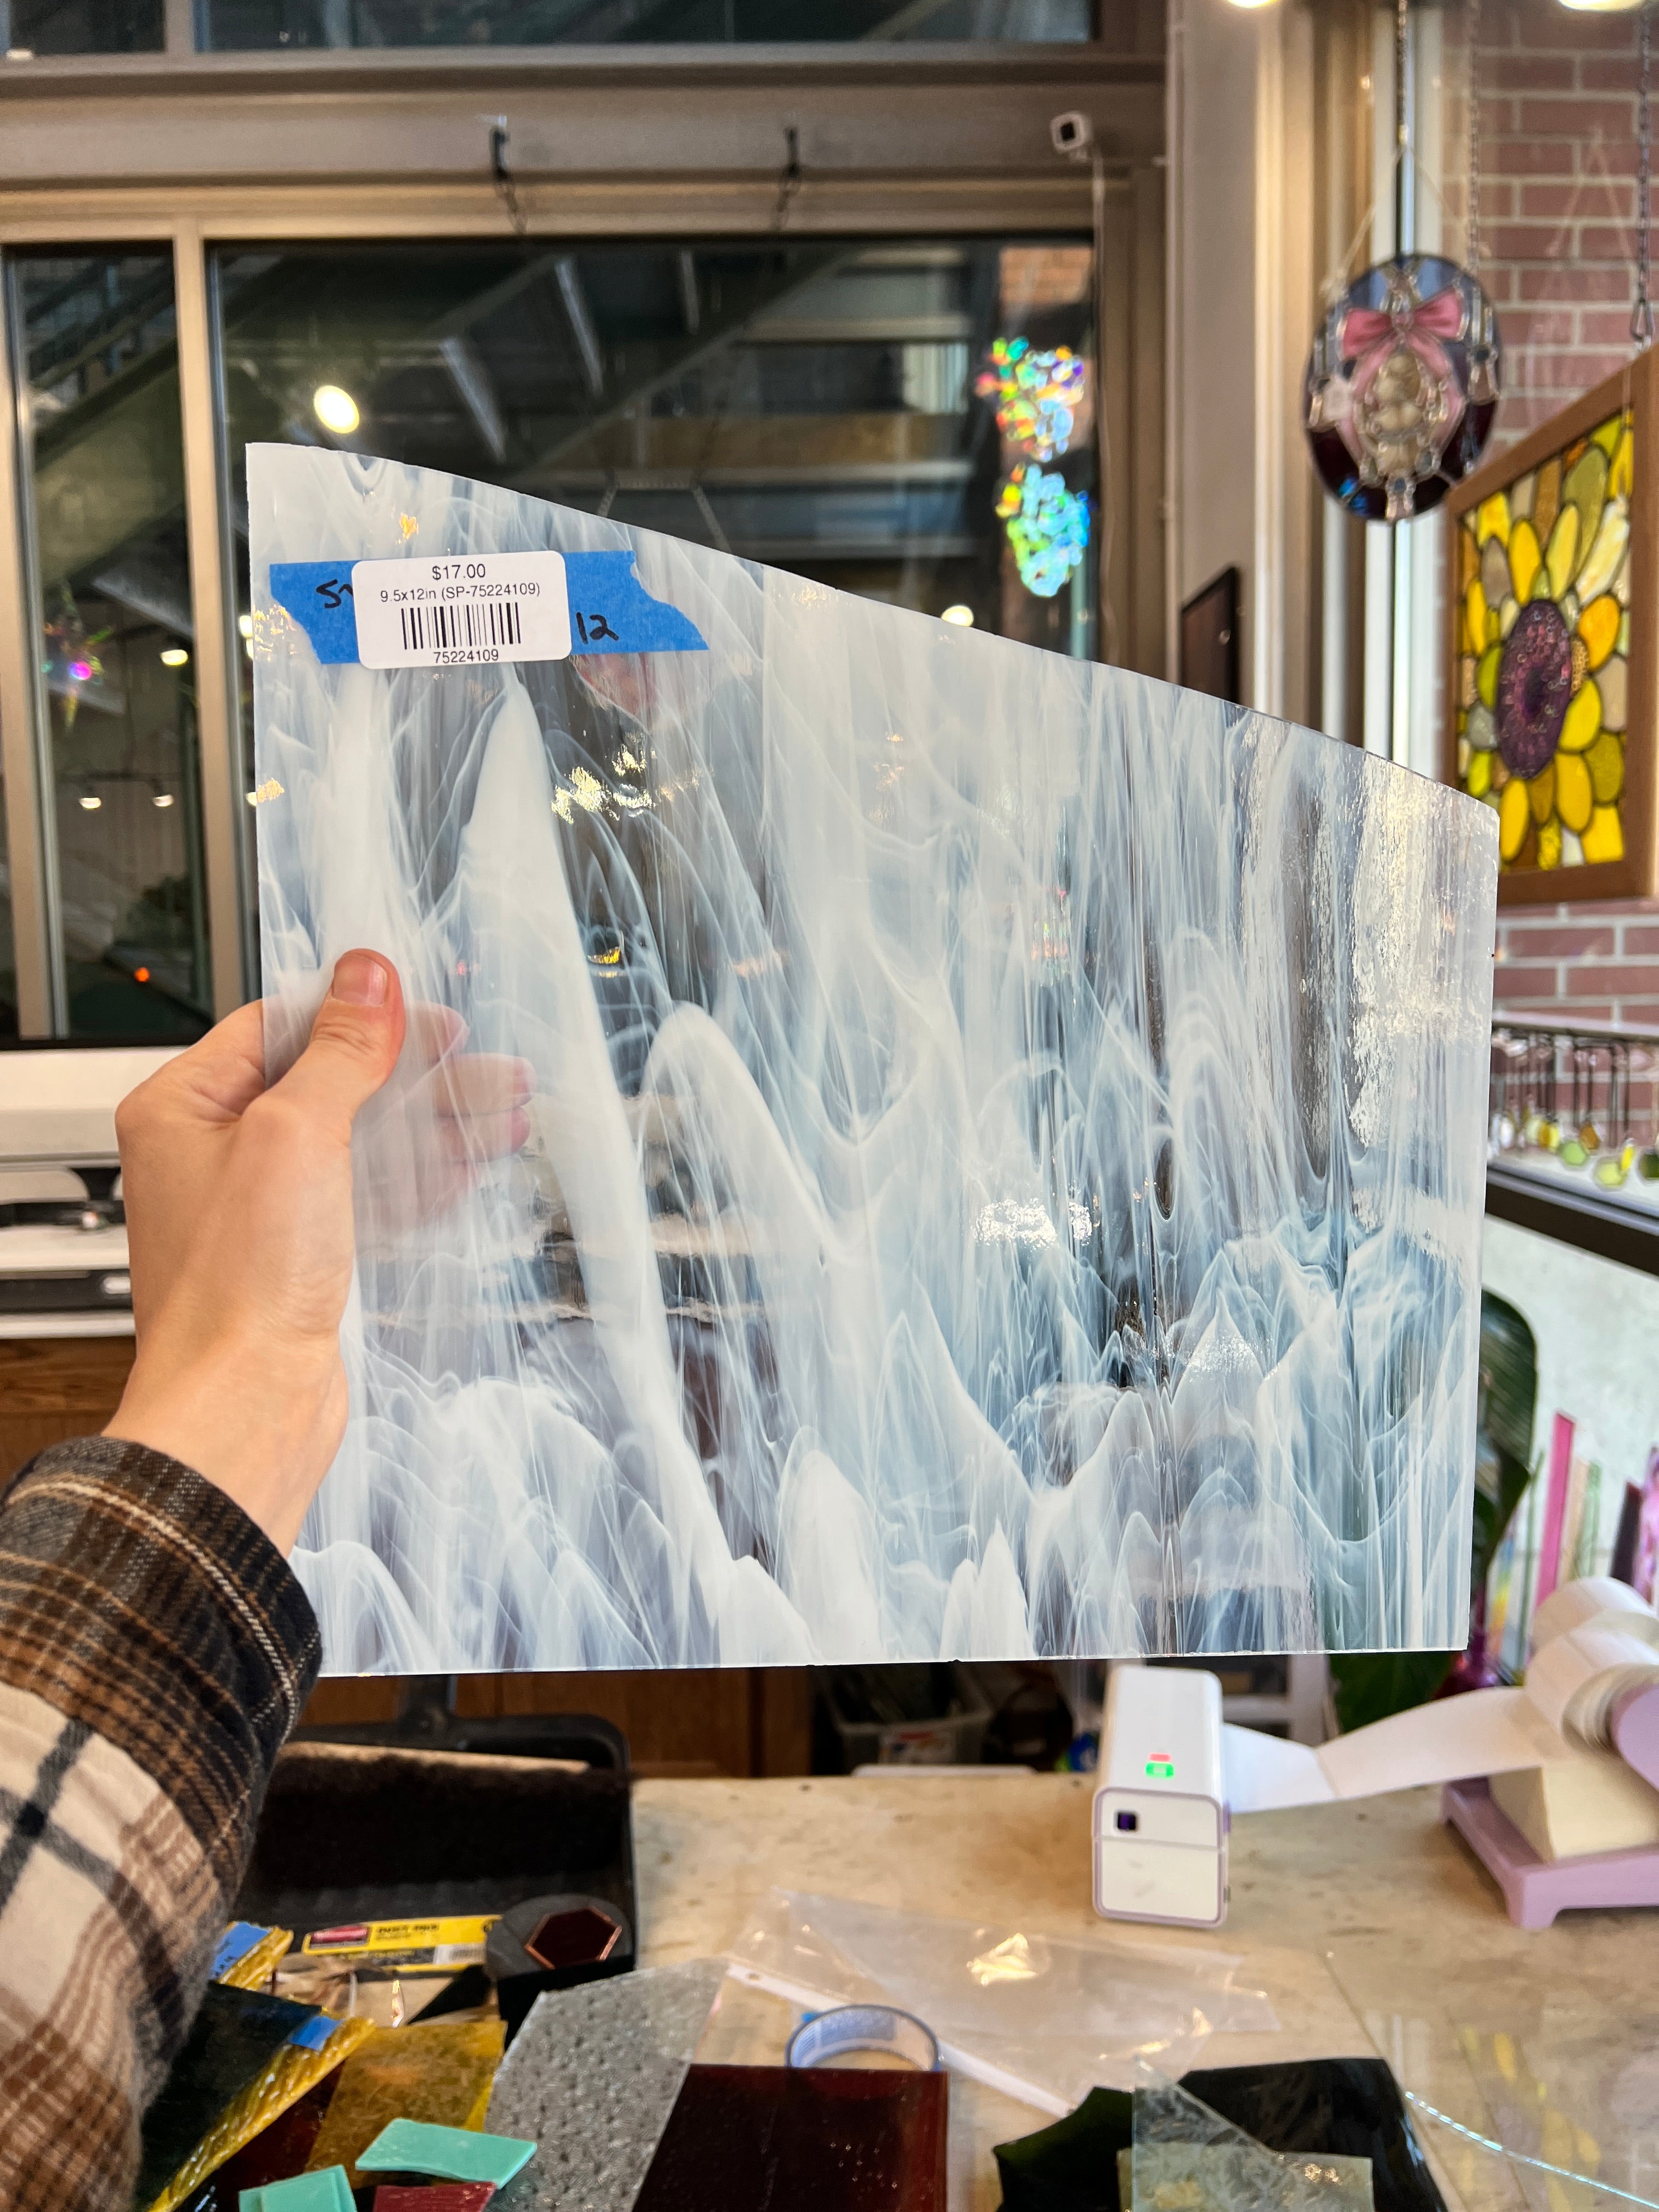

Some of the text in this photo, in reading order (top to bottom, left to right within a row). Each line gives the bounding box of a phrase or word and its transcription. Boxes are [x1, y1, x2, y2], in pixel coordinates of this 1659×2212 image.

[432, 563, 486, 580] $17.00
[380, 582, 540, 602] 9.5x12in (SP-75224109)
[576, 612, 619, 645] 12
[433, 648, 499, 664] 75224109
